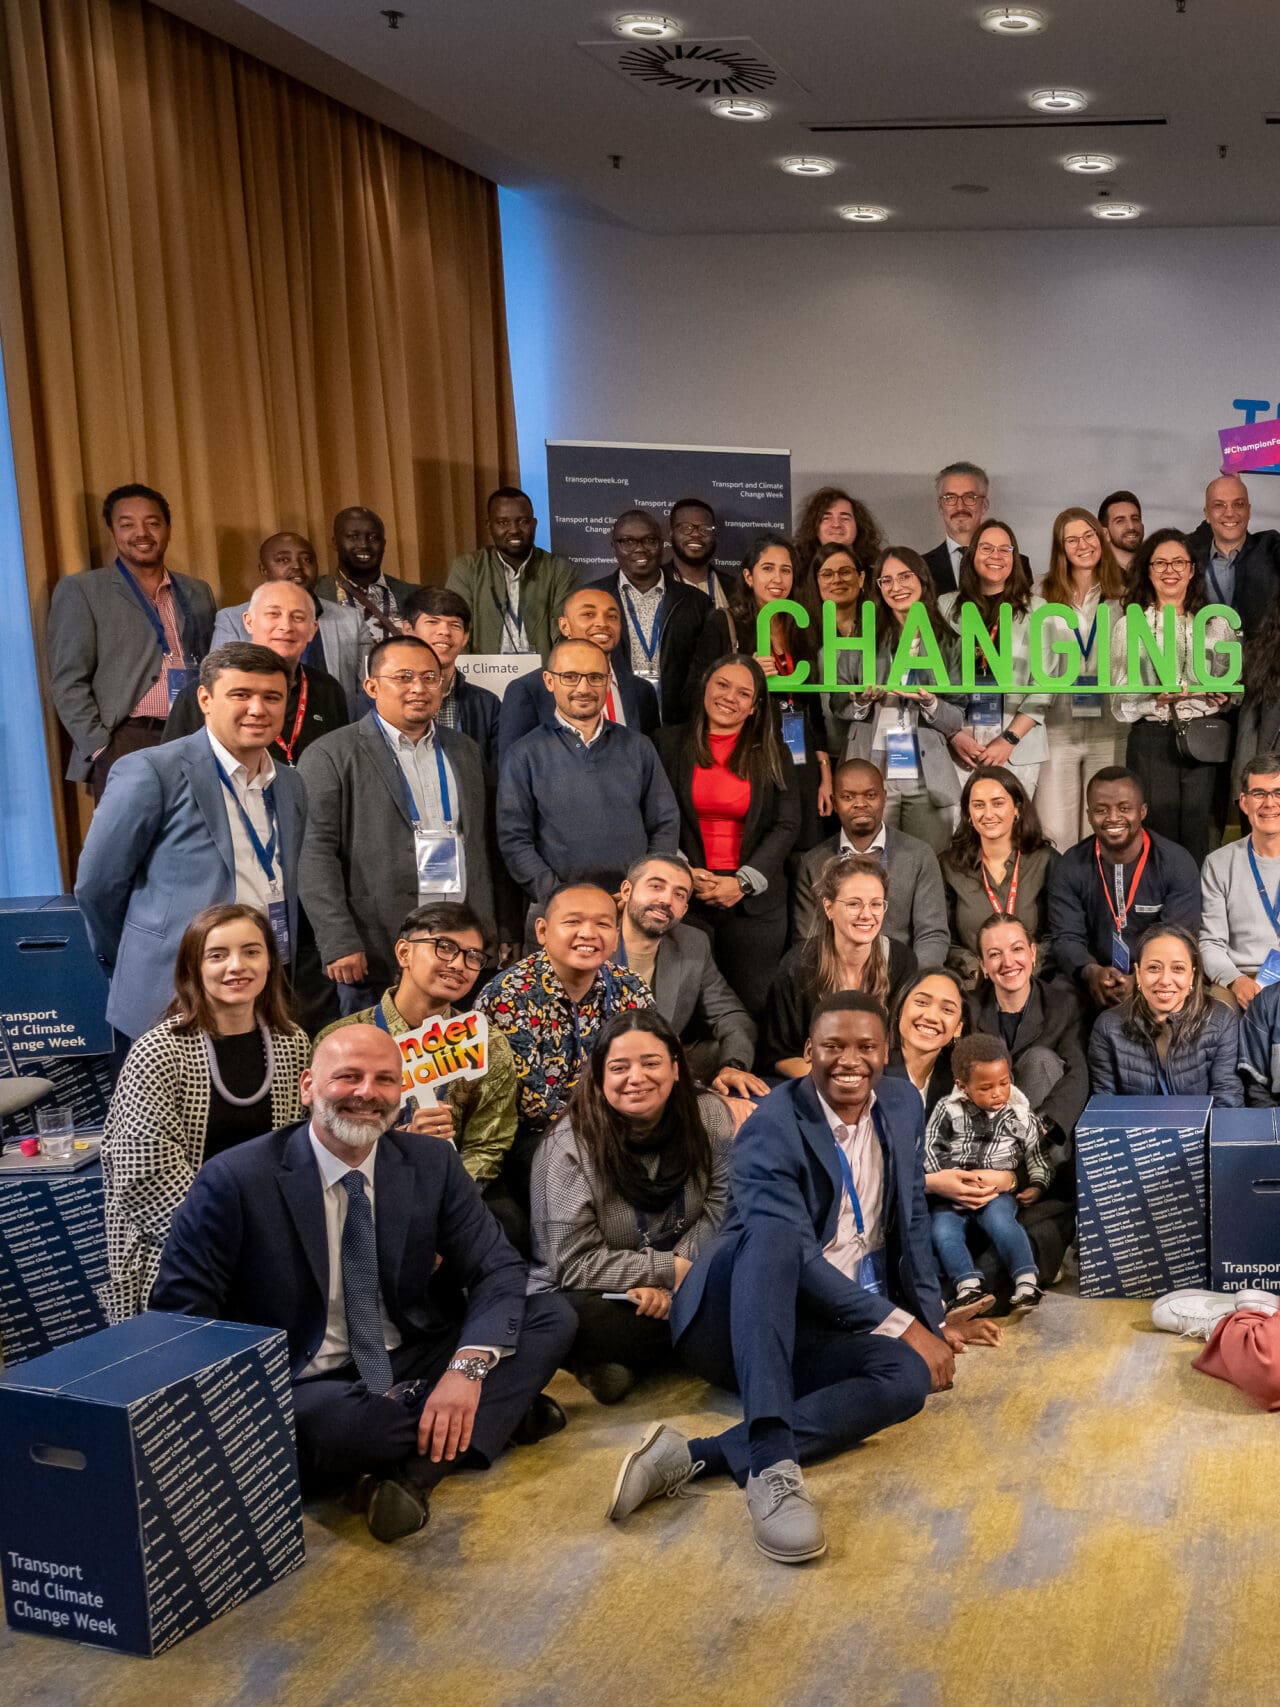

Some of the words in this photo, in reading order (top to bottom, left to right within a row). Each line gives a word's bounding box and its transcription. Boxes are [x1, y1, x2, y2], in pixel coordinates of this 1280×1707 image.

[565, 475, 629, 486] transportweek.org
[712, 480, 744, 490] Transport
[758, 482, 784, 490] Climate
[740, 490, 763, 499] Change
[634, 500, 666, 508] Transport
[555, 516, 588, 524] Transport
[590, 516, 602, 524] and
[724, 520, 784, 530] transportweek.org
[585, 526, 610, 534] Change
[568, 556, 618, 564] ransportweek
[714, 559, 742, 567] Transpo
[756, 599, 1243, 687] CHANGING
[473, 664, 518, 674] Climate
[1, 1010, 58, 1022] ansport
[22, 1024, 76, 1036] Climate
[48, 1036, 86, 1048] Week
[399, 1014, 478, 1062] nder
[402, 1041, 484, 1092] uality
[1222, 1278, 1248, 1290] and
[8, 1552, 83, 1581] Transport
[12, 1578, 40, 1596] and
[44, 1582, 104, 1608] Climate
[14, 1600, 70, 1627] Change
[73, 1612, 118, 1636] Week
